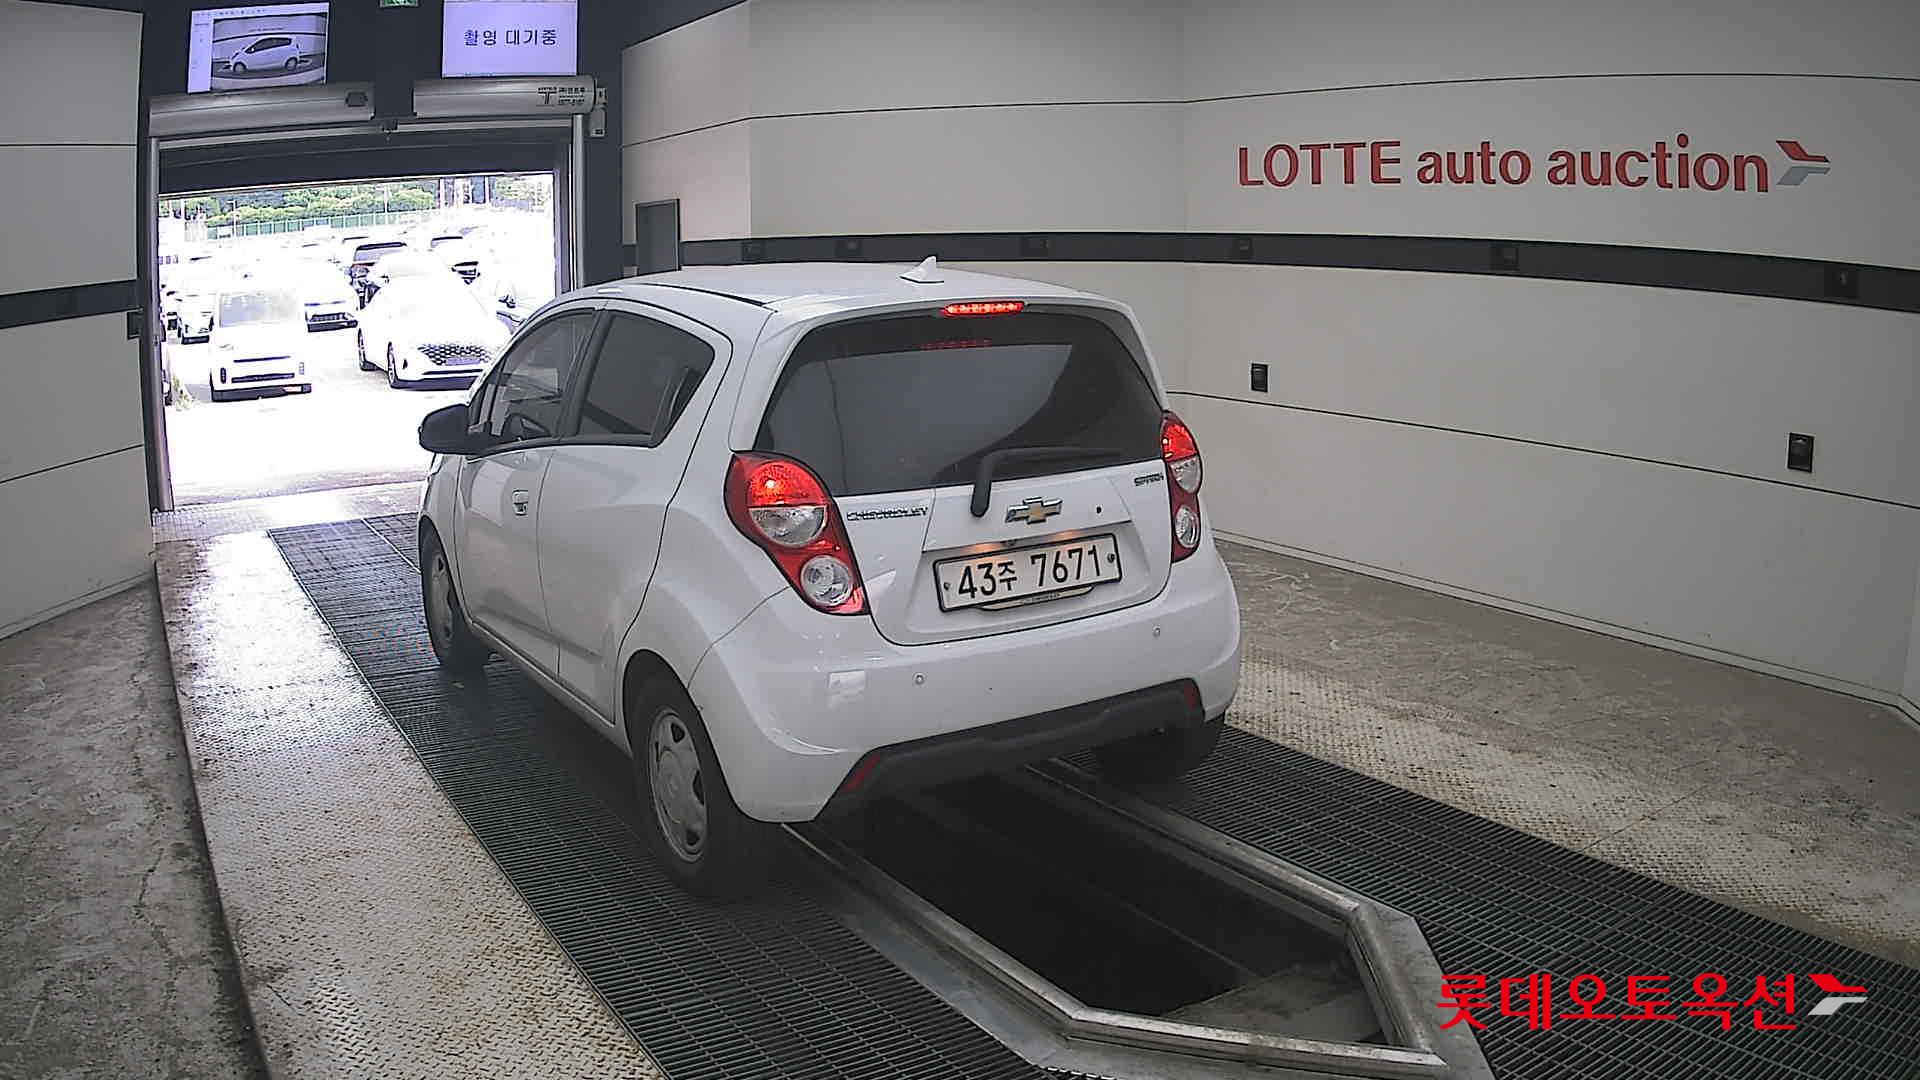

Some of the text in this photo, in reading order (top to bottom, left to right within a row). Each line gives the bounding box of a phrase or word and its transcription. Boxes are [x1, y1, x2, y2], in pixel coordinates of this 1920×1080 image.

[505, 29, 558, 46] 대기중
[1239, 133, 1768, 192] LOTTE auto auction
[958, 545, 1101, 599] 43주 7671
